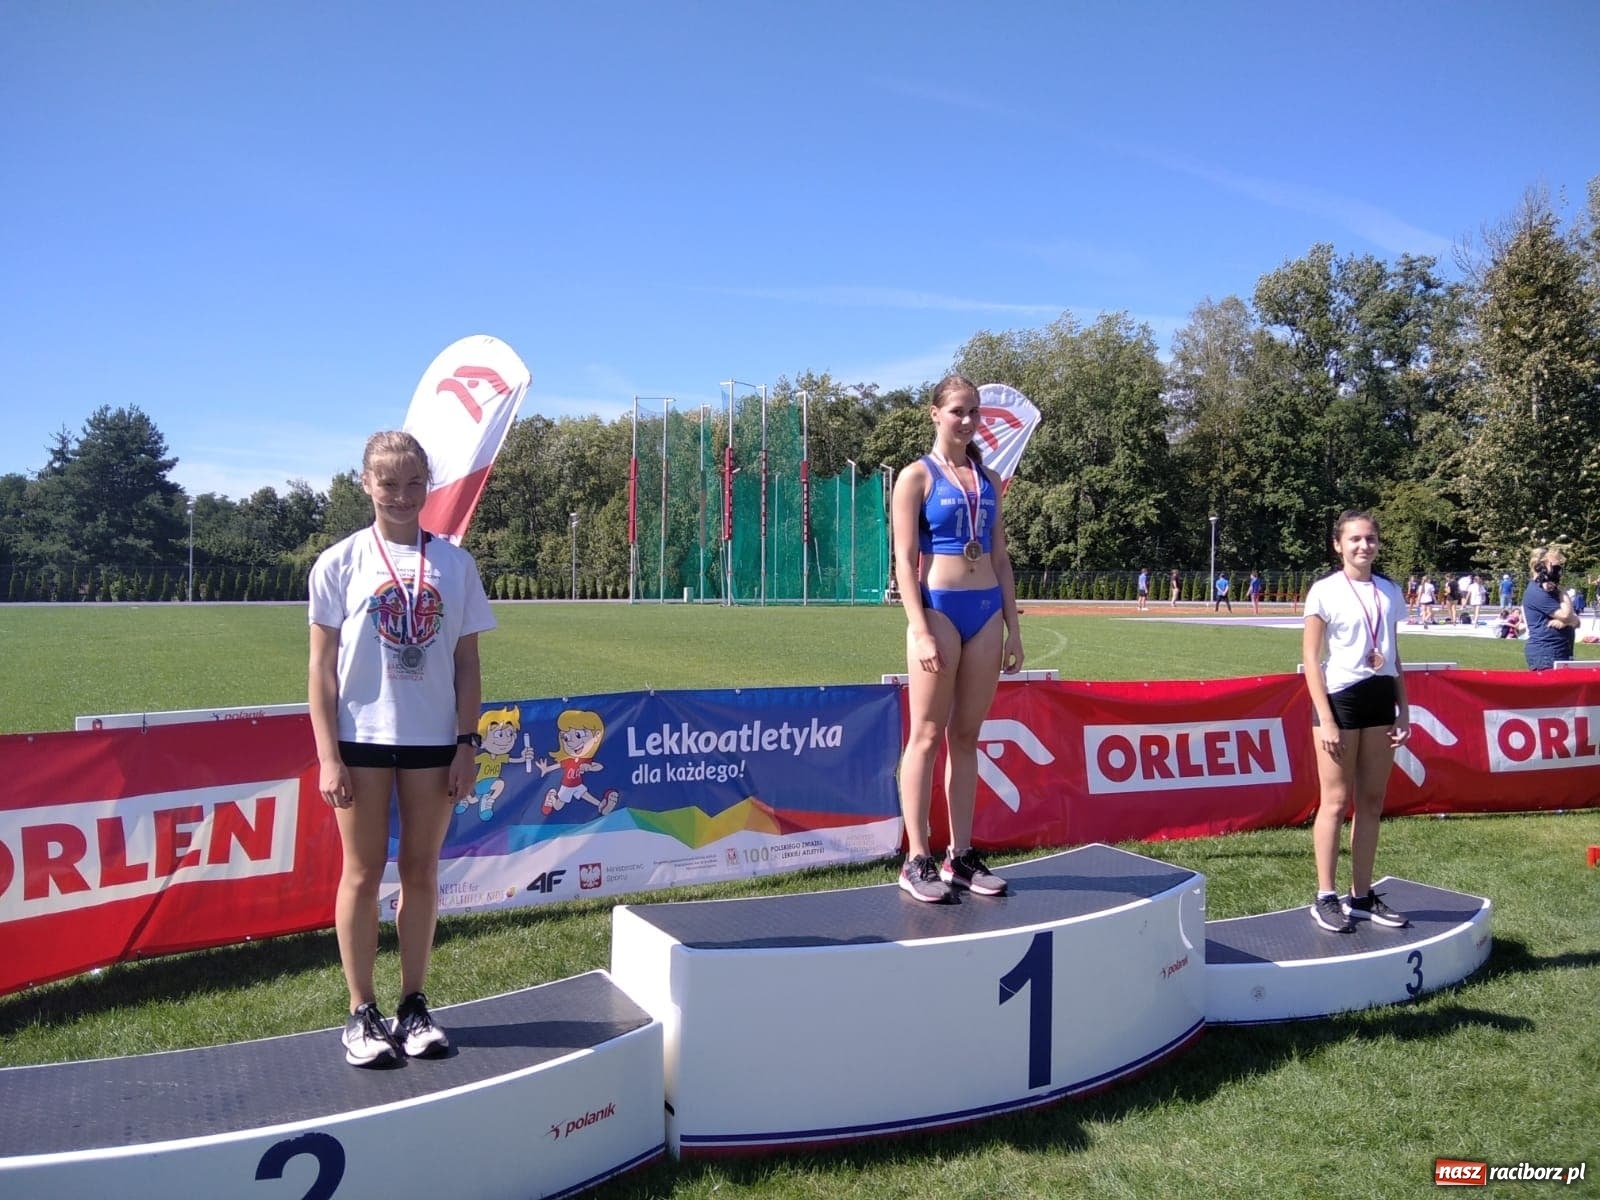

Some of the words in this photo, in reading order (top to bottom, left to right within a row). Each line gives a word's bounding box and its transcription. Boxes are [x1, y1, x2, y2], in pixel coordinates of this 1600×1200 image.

[627, 717, 843, 757] Lekkoatletyka
[1097, 729, 1276, 782] ORLEN
[1497, 716, 1600, 762] ORL
[631, 764, 661, 785] dla
[666, 759, 746, 783] każdego!
[0, 796, 277, 901] RLEN
[743, 847, 769, 863] 100
[526, 869, 567, 893] 4F
[1406, 950, 1424, 995] 3
[999, 931, 1053, 1090] 1
[564, 1101, 616, 1138] polanik
